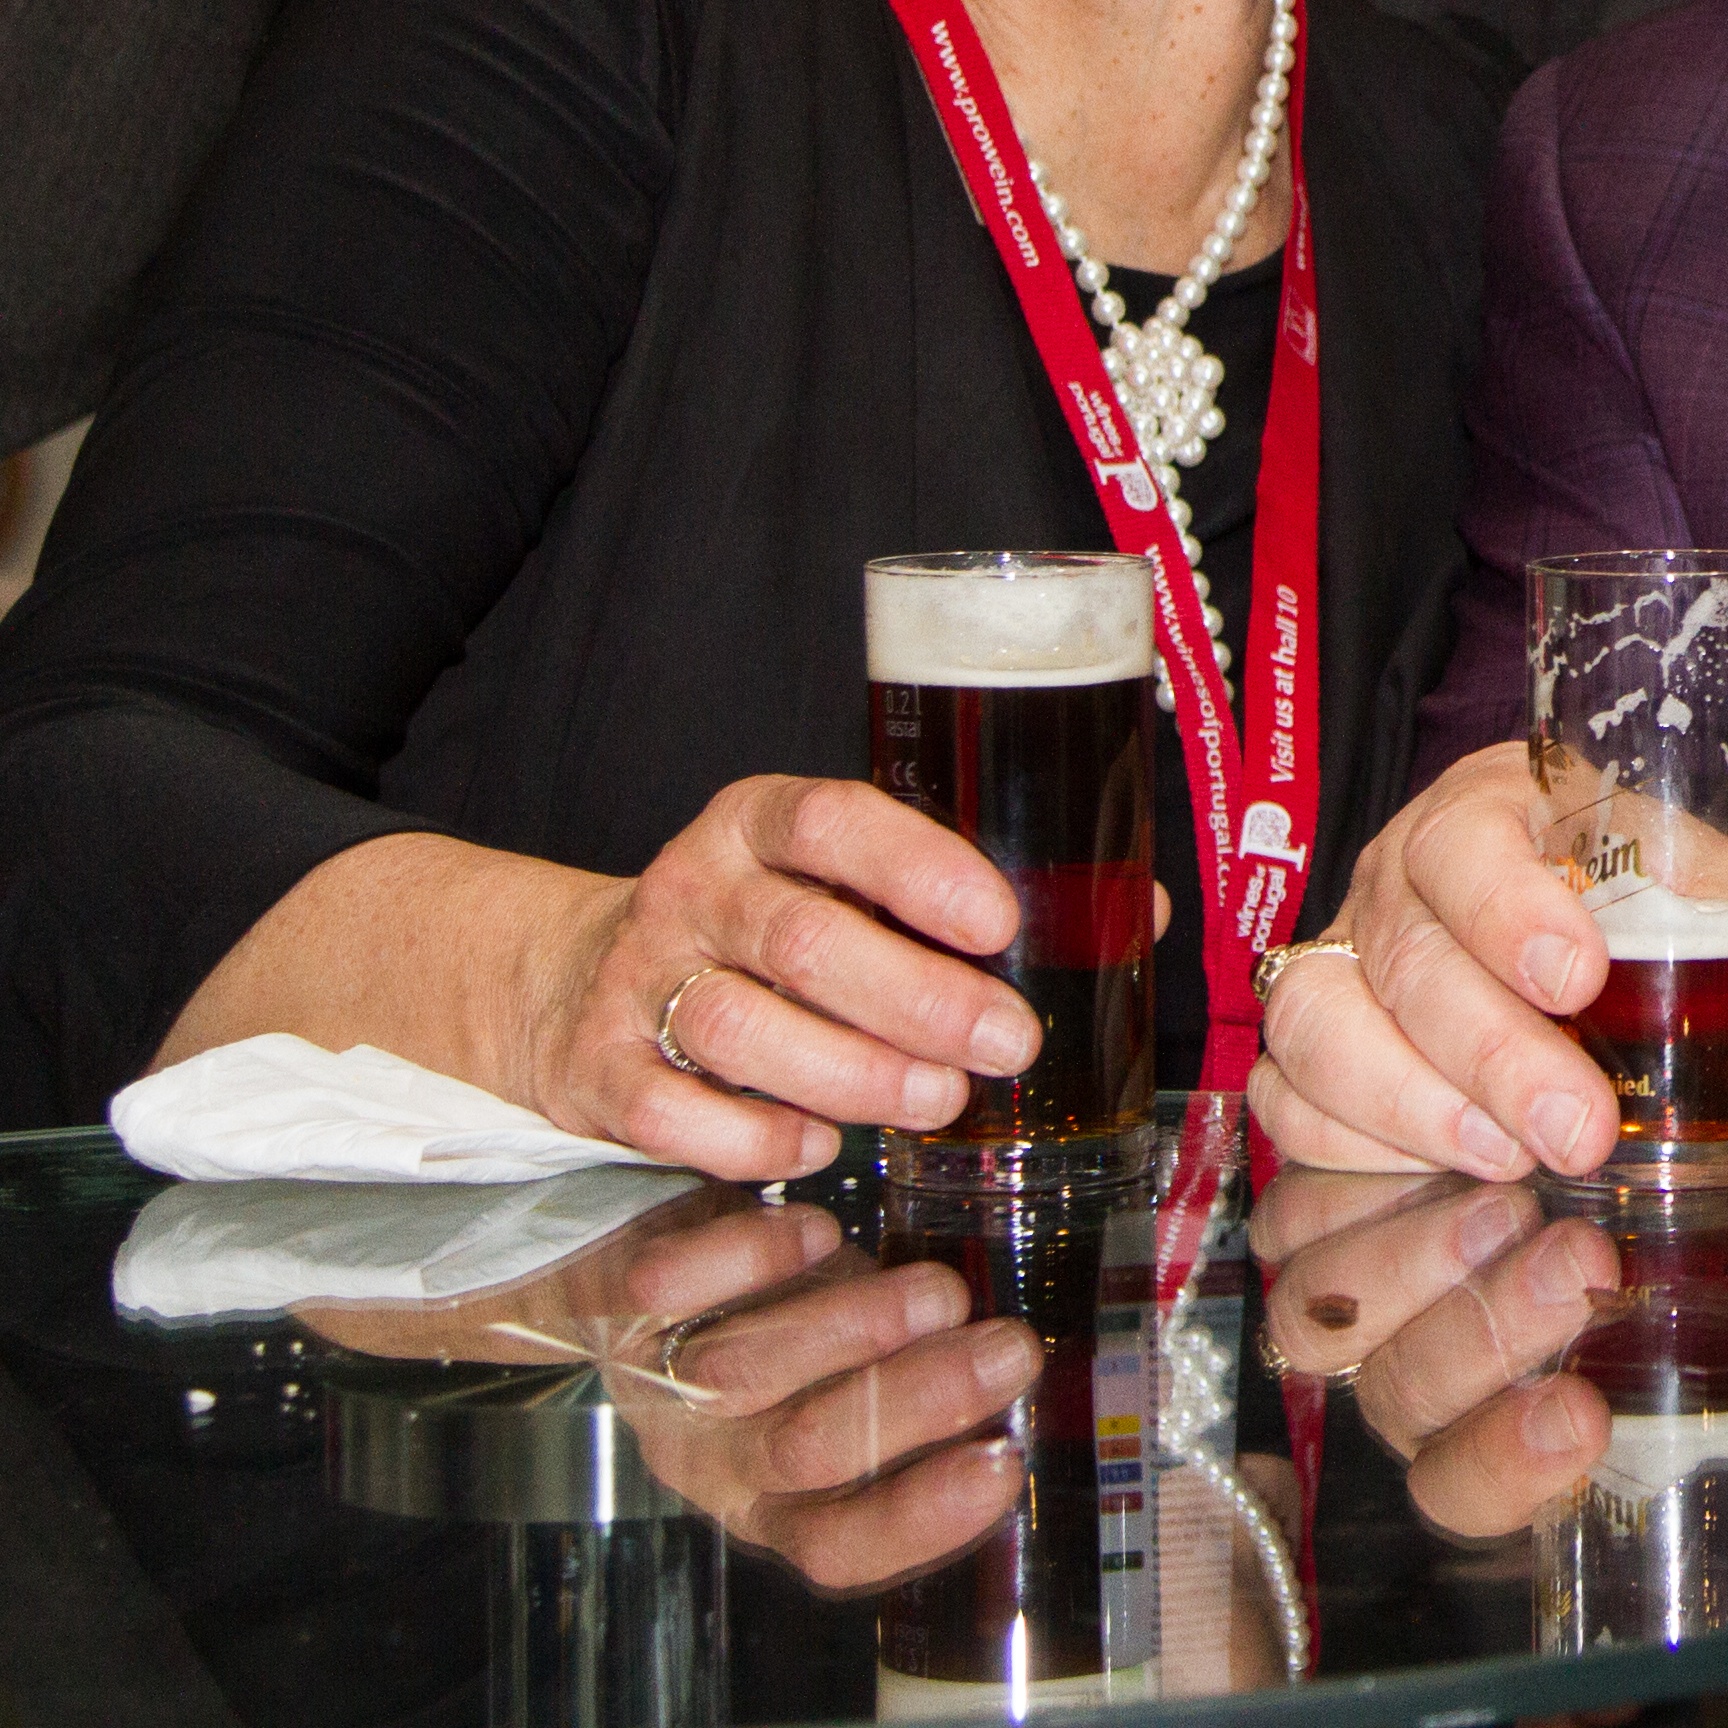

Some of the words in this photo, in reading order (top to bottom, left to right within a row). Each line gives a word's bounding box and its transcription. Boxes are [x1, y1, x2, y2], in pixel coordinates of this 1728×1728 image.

[931, 19, 1040, 268] www.prowein.com
[1275, 583, 1299, 618] 10
[1269, 613, 1298, 667] hall
[1272, 666, 1296, 696] at
[1274, 696, 1295, 729] us
[1269, 729, 1296, 783] Visit
[1236, 875, 1265, 938] wines
